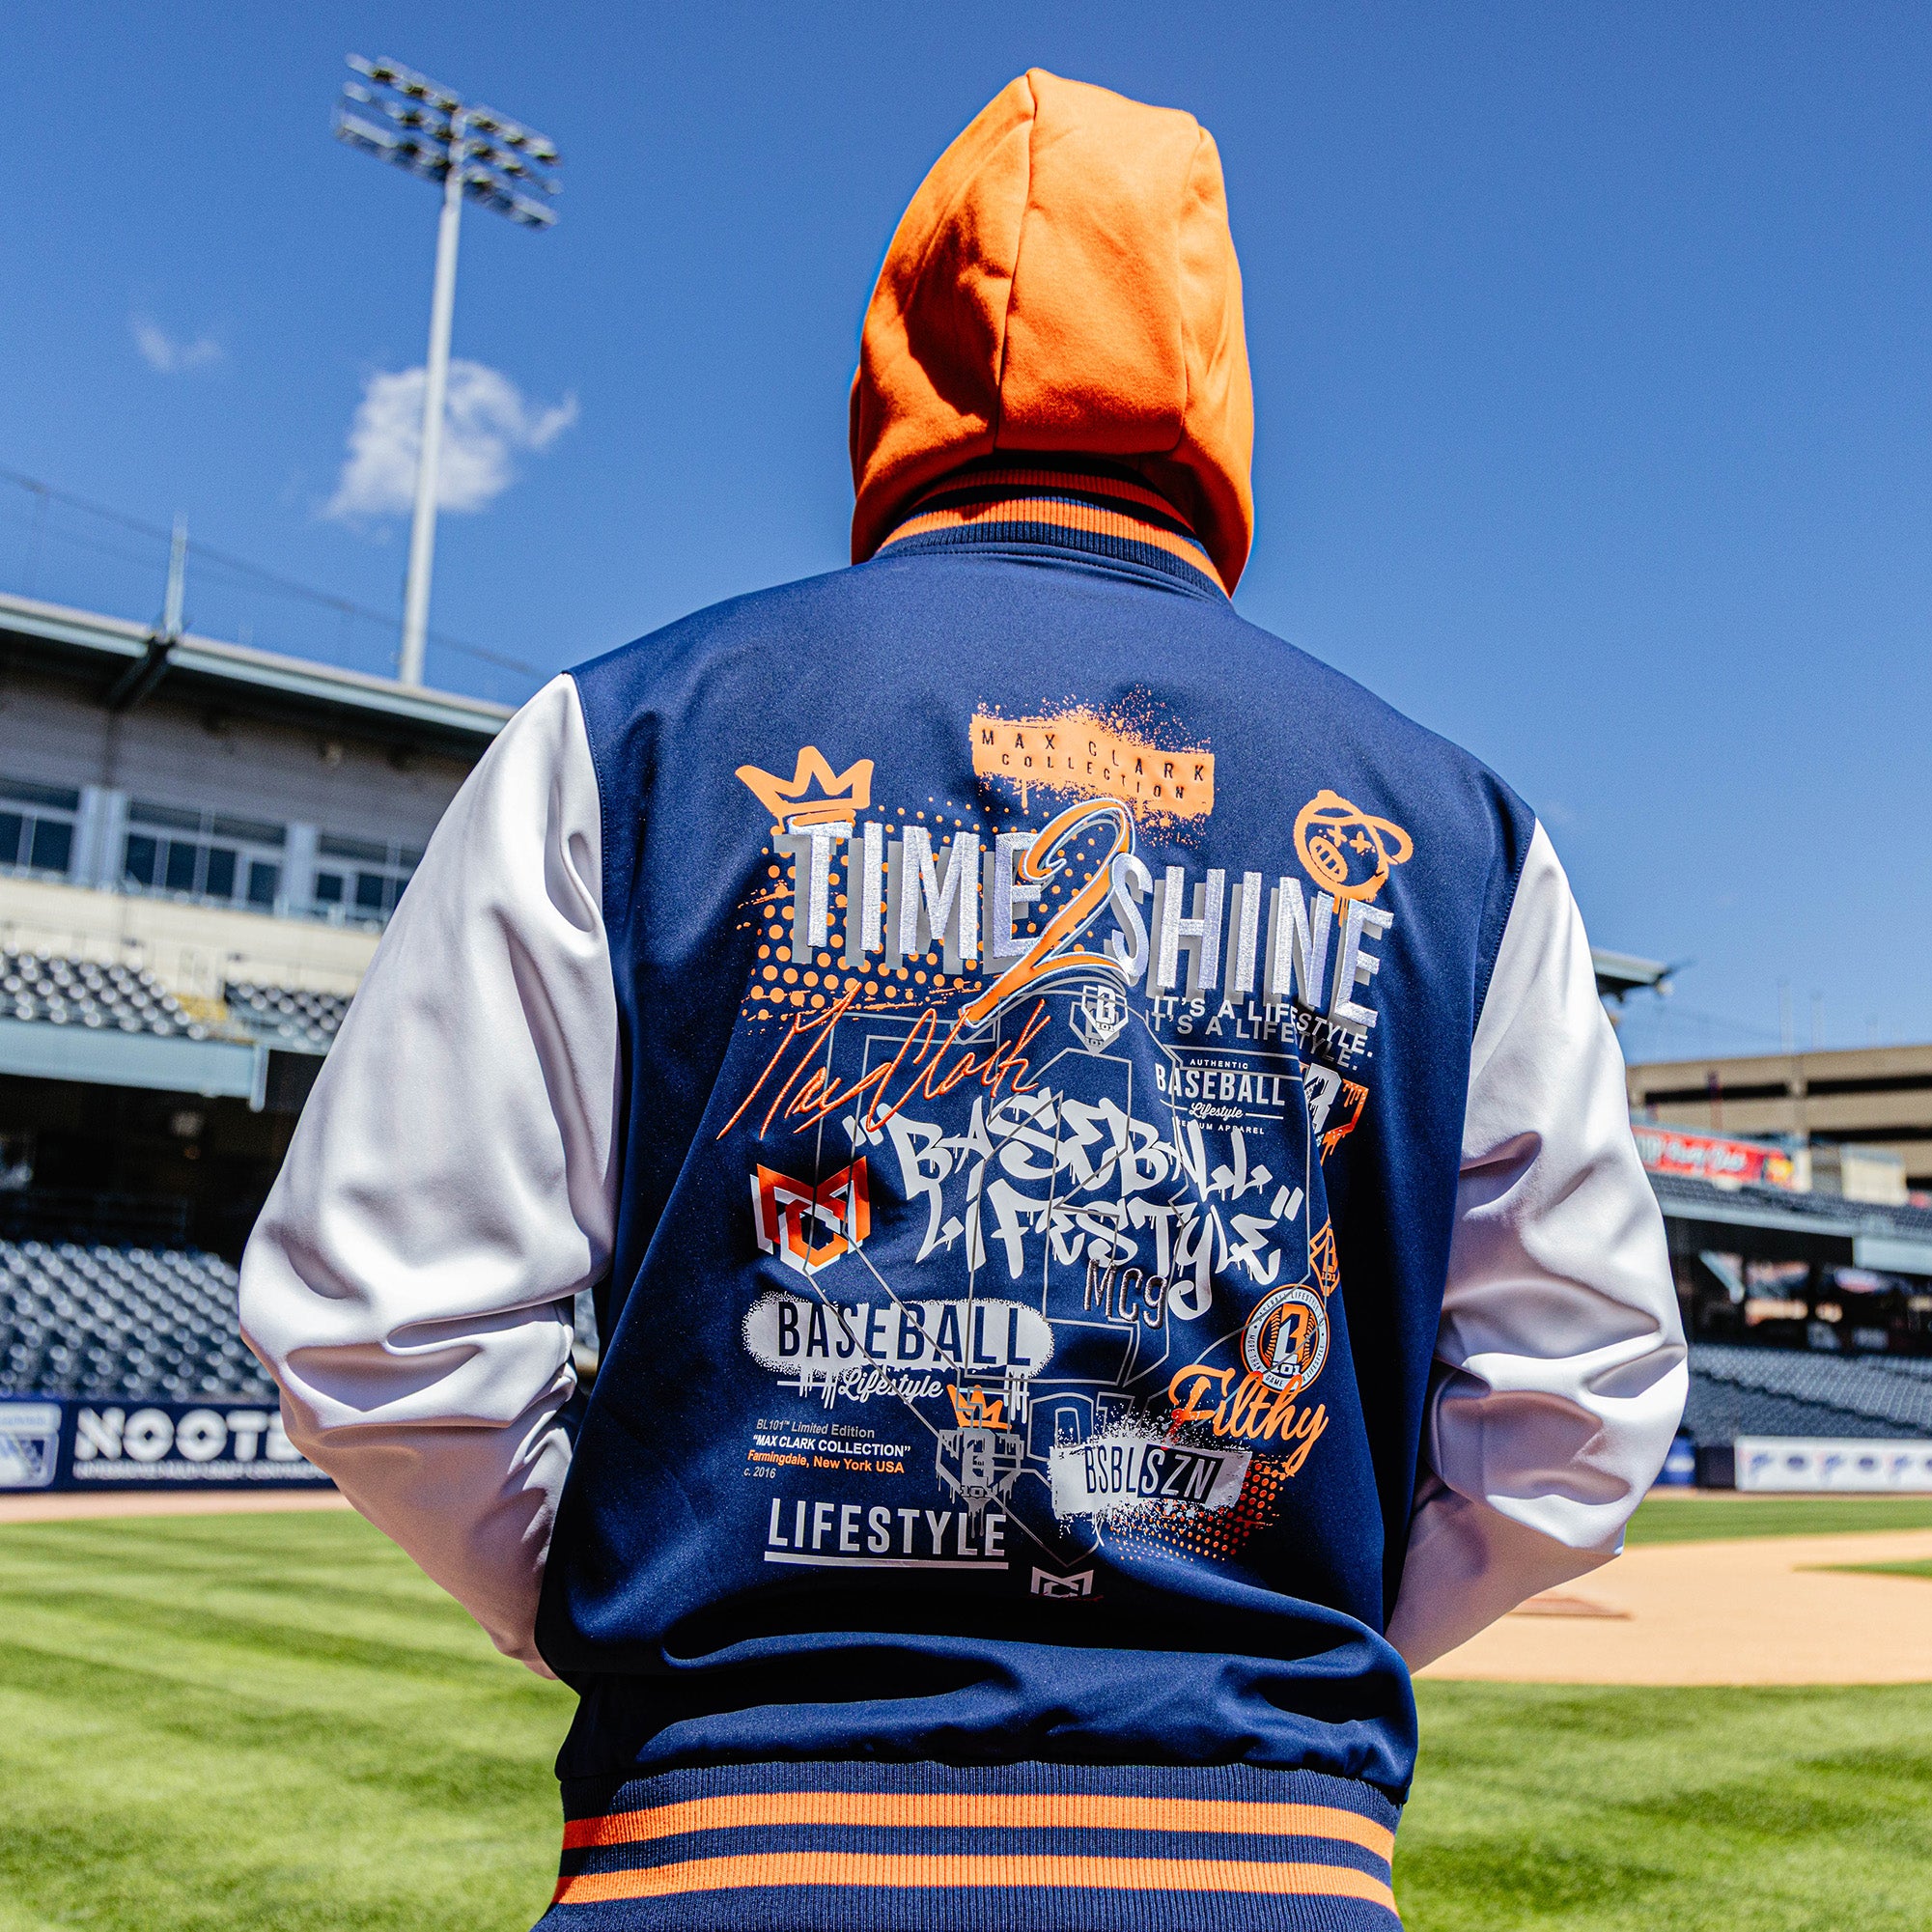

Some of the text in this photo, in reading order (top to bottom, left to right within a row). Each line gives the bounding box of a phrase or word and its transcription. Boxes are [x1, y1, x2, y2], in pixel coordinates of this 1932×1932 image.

[982, 729, 1205, 782] MAX CLARK
[1001, 753, 1185, 799] COLLECTION
[788, 797, 1394, 1029] TIME 2 SHINE
[1154, 995, 1206, 1018] IT'S
[1218, 999, 1236, 1021] A
[1190, 1058, 1248, 1070] AUTHENTIC
[1155, 1062, 1285, 1106] BASEBALL
[1189, 1102, 1244, 1121] Lifestyle
[778, 1301, 1031, 1367] BASEBALL
[839, 1367, 945, 1403] Lifestyle
[791, 1421, 827, 1435] Limited
[831, 1424, 875, 1439] Edition
[1168, 1364, 1330, 1477] Filthy
[747, 1449, 905, 1473] Farmingdale, New York USA
[778, 1436, 816, 1450] CLARK
[753, 1466, 776, 1479] 2016
[769, 1498, 1007, 1556] LIFESTYLE
